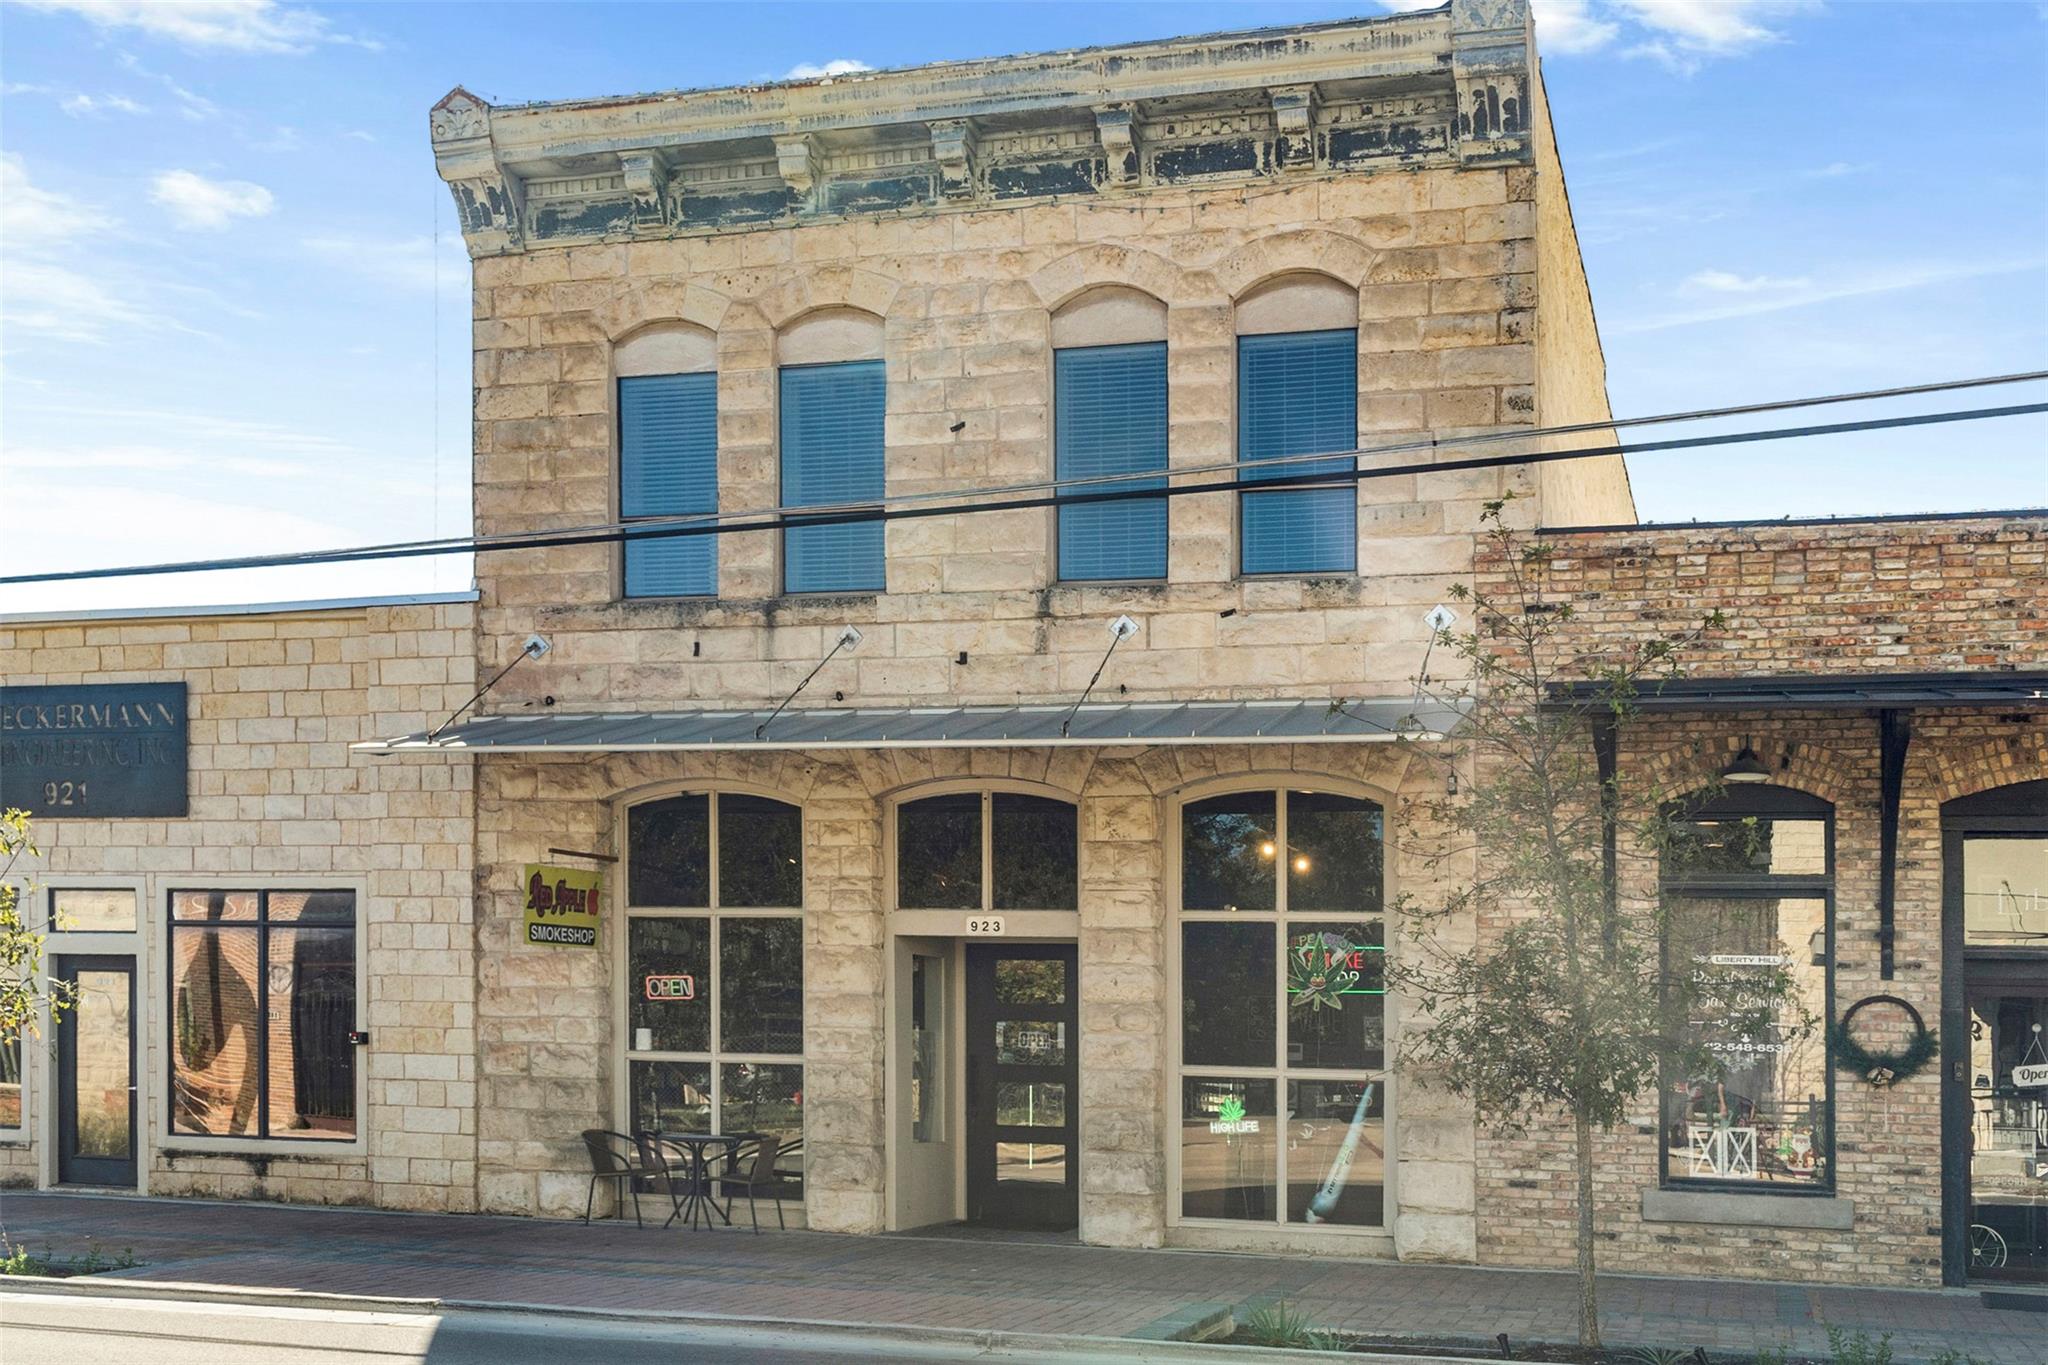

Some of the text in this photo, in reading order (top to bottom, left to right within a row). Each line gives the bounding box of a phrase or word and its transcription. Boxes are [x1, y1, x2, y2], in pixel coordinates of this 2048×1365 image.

[44, 781, 87, 806] 921
[970, 920, 1001, 932] 923
[530, 925, 595, 943] SMOKESHOP
[1758, 956, 1778, 964] HILL
[650, 979, 691, 996] OPEN
[1210, 1120, 1260, 1134] HIGH LIFE
